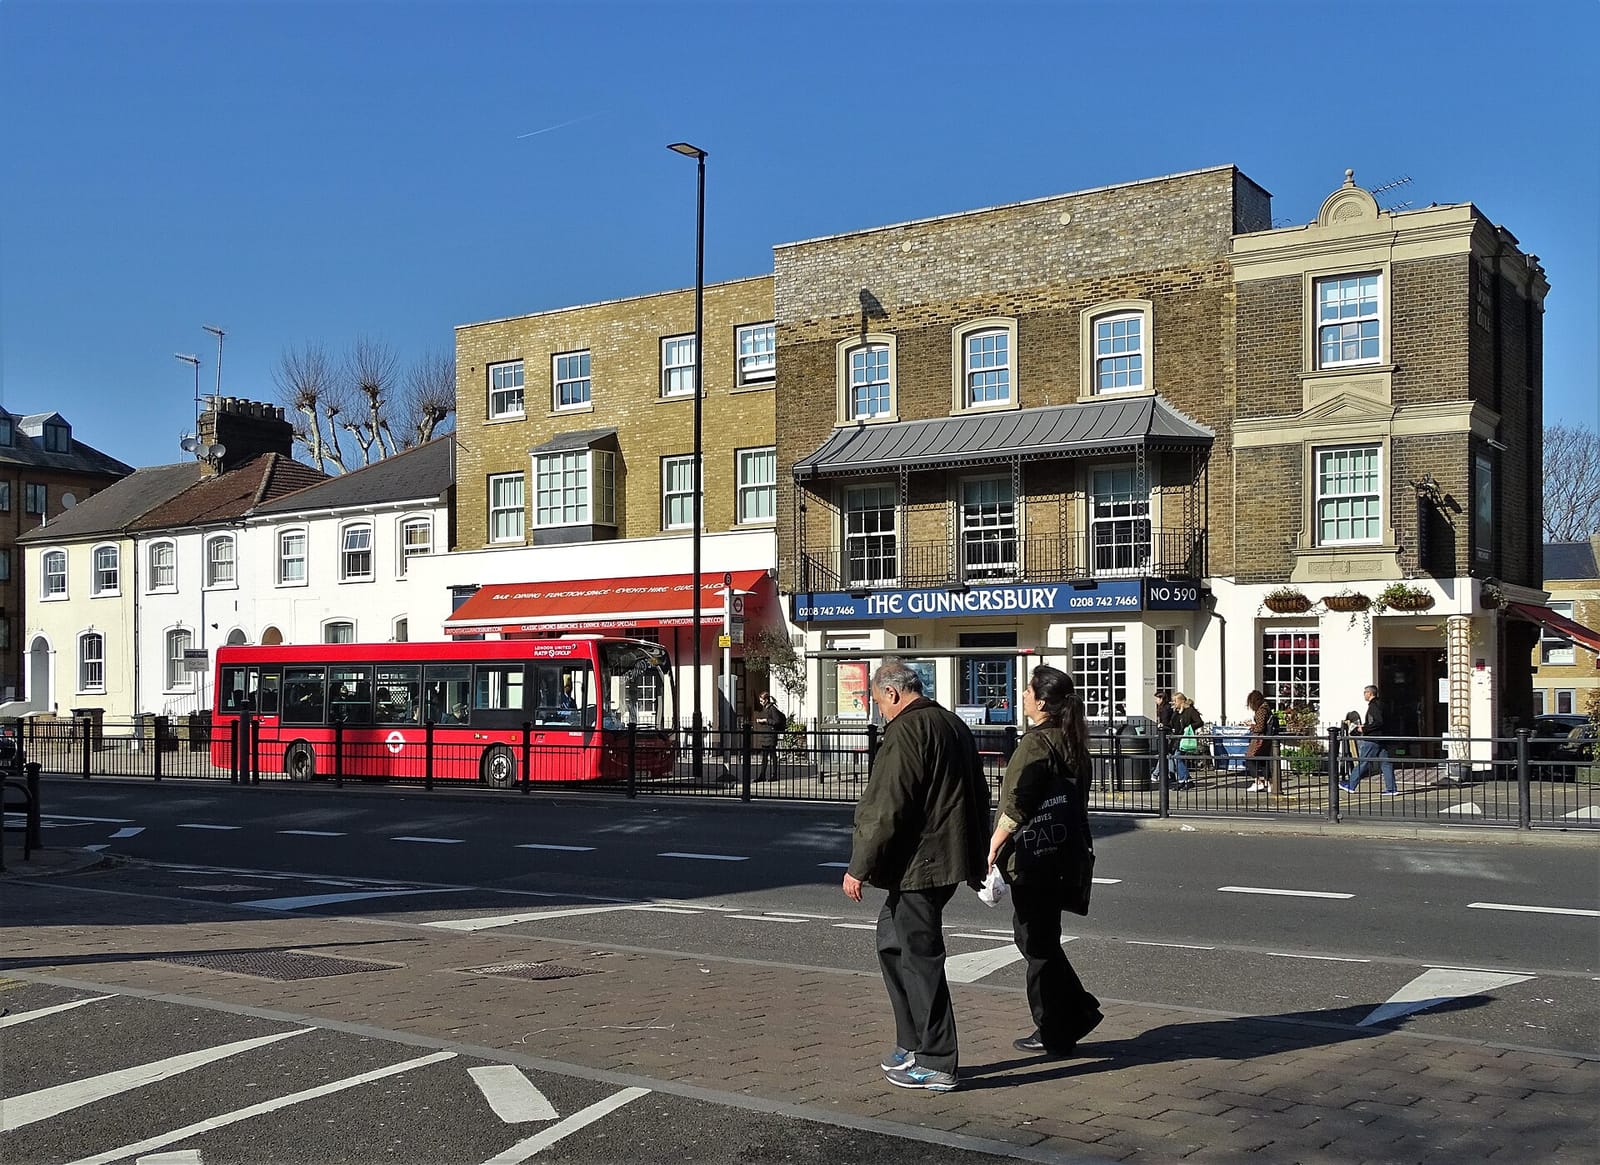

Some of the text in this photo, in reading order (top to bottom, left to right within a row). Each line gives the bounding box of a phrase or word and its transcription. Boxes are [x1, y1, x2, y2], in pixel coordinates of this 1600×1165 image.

[673, 584, 695, 592] GUES
[1150, 587, 1197, 601] NO 590
[864, 587, 1059, 615] THE GUNNERSBURY
[1070, 595, 1138, 608] 0208 742 7466
[799, 606, 855, 617] 0208 742 7466
[1034, 813, 1052, 823] LOVES
[1022, 824, 1067, 848] PAD
